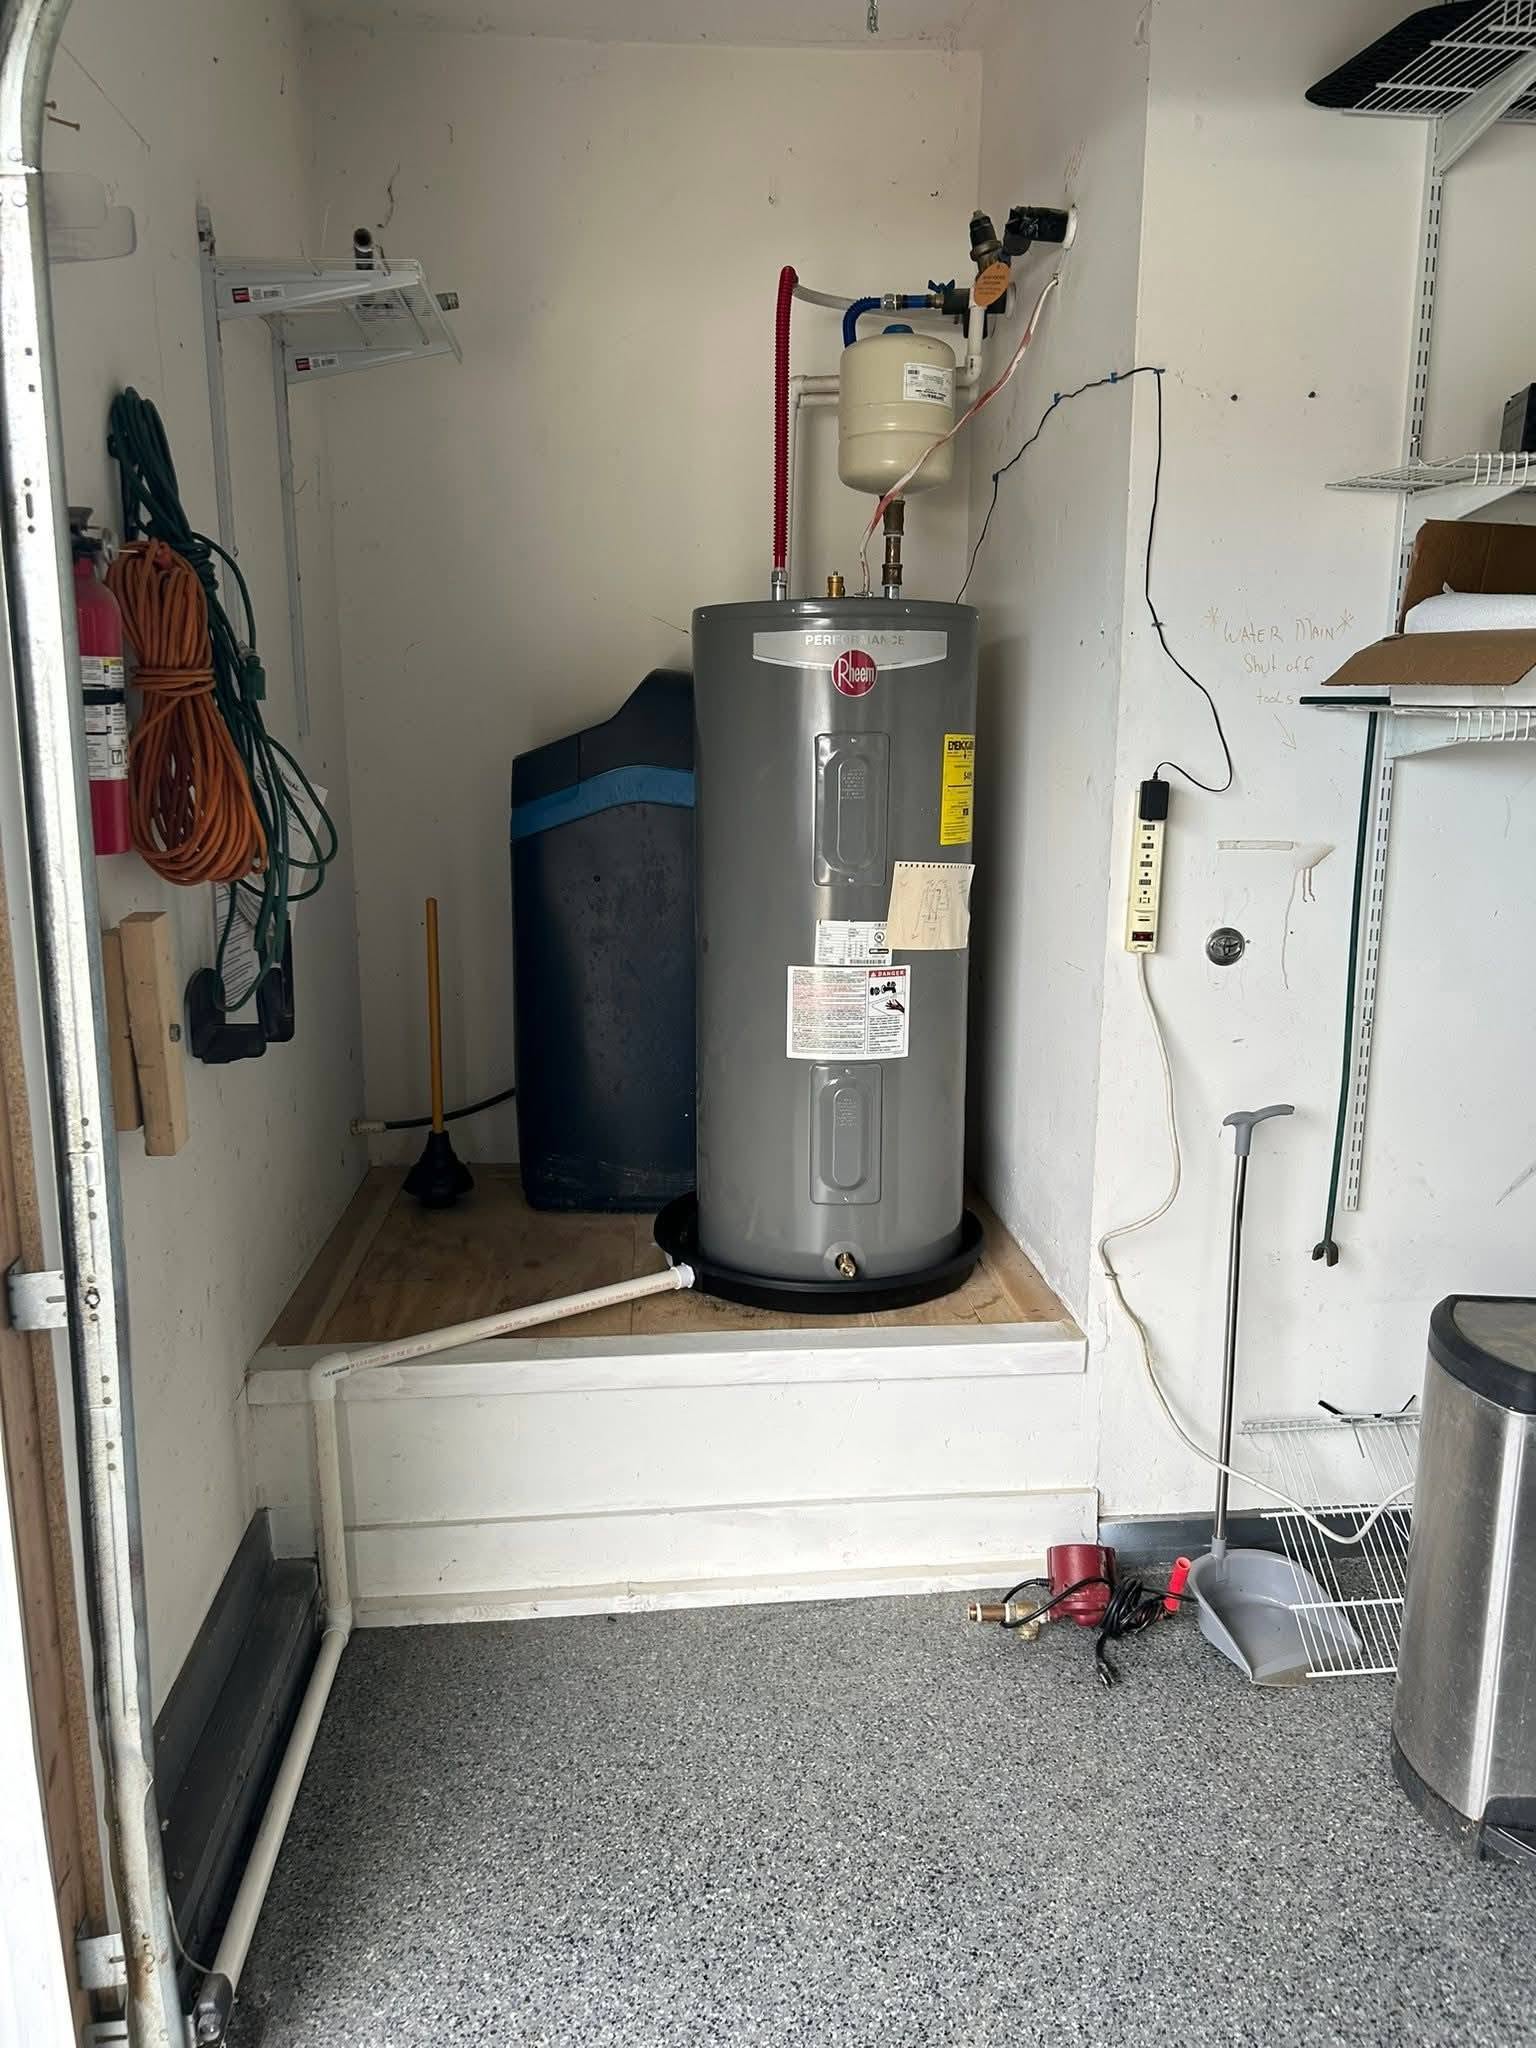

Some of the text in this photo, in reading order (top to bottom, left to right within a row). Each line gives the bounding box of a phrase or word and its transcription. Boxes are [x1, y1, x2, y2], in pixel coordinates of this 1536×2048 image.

[1296, 617, 1335, 641] MAIN
[837, 657, 875, 688] Rheem
[1243, 653, 1315, 674] Shut off
[1256, 688, 1295, 705] tools
